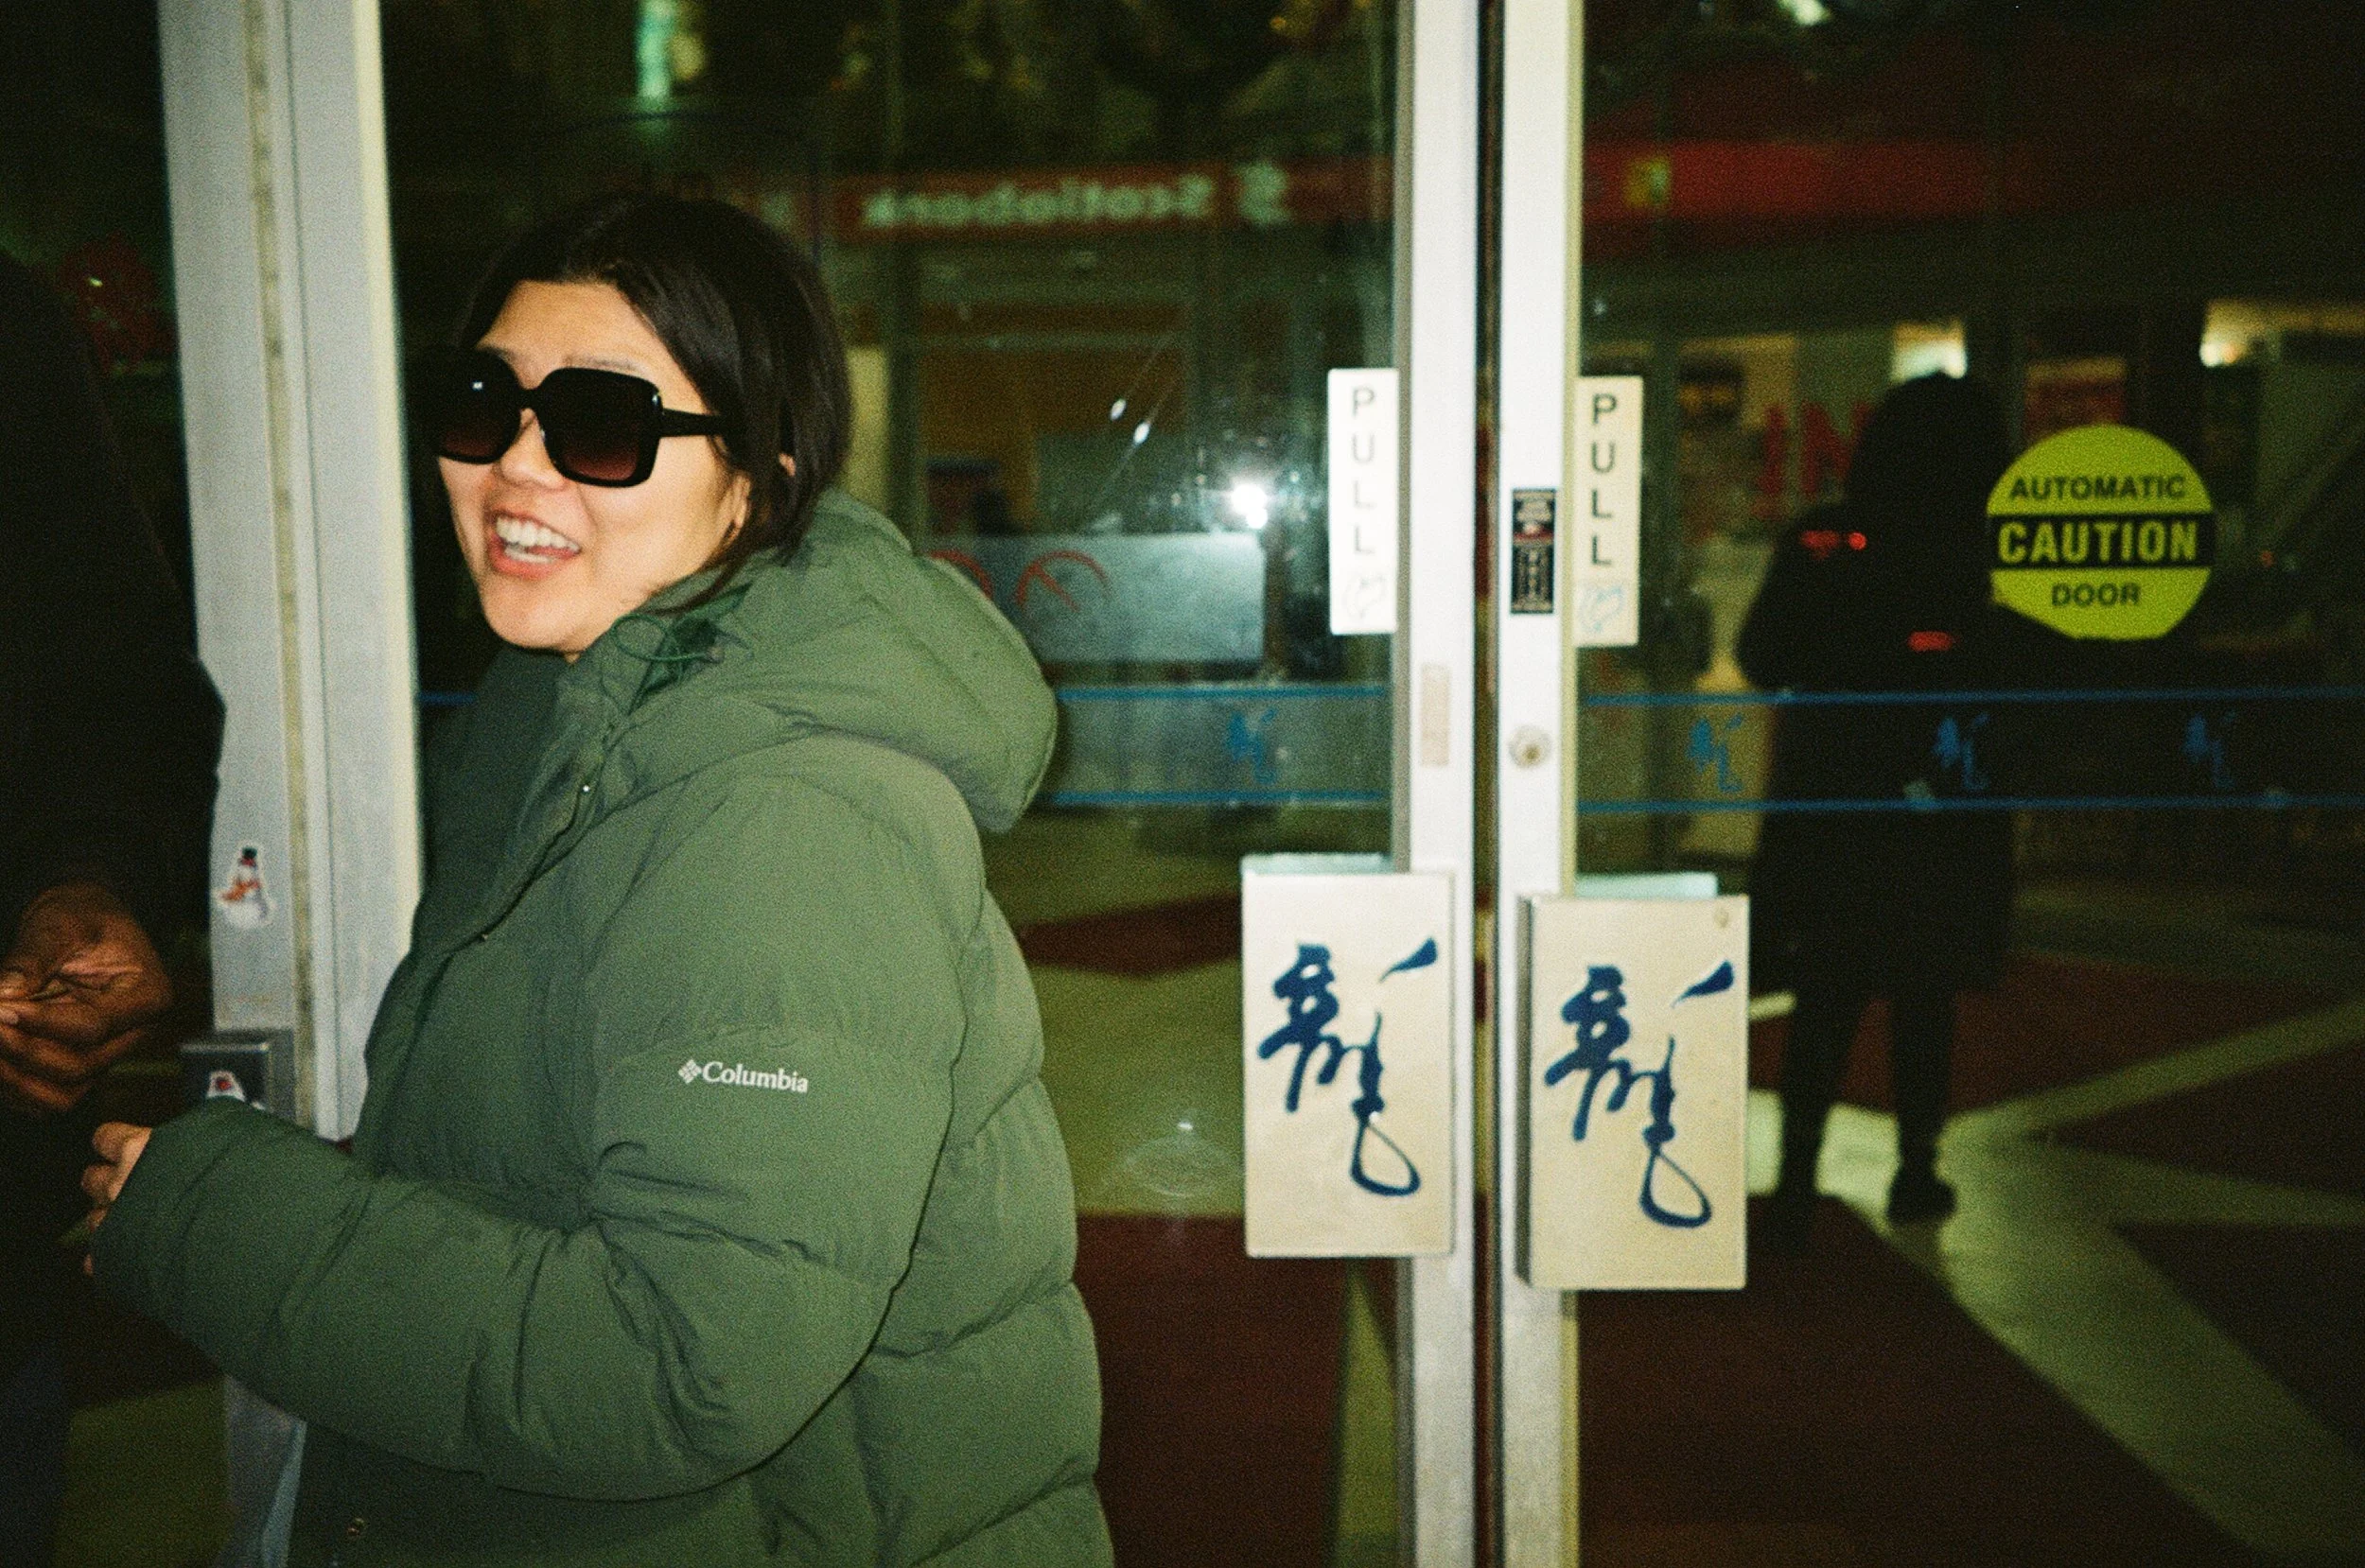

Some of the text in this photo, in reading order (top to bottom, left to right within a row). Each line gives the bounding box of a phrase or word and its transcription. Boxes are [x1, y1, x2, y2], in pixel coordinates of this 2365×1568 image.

[1351, 388, 1376, 555] PULL
[1591, 393, 1618, 566] PULL
[2009, 476, 2186, 500] AUTOMATIC
[1997, 522, 2198, 563] CAUTION
[2051, 583, 2140, 606] DOOR
[703, 1061, 810, 1093] Columbia
